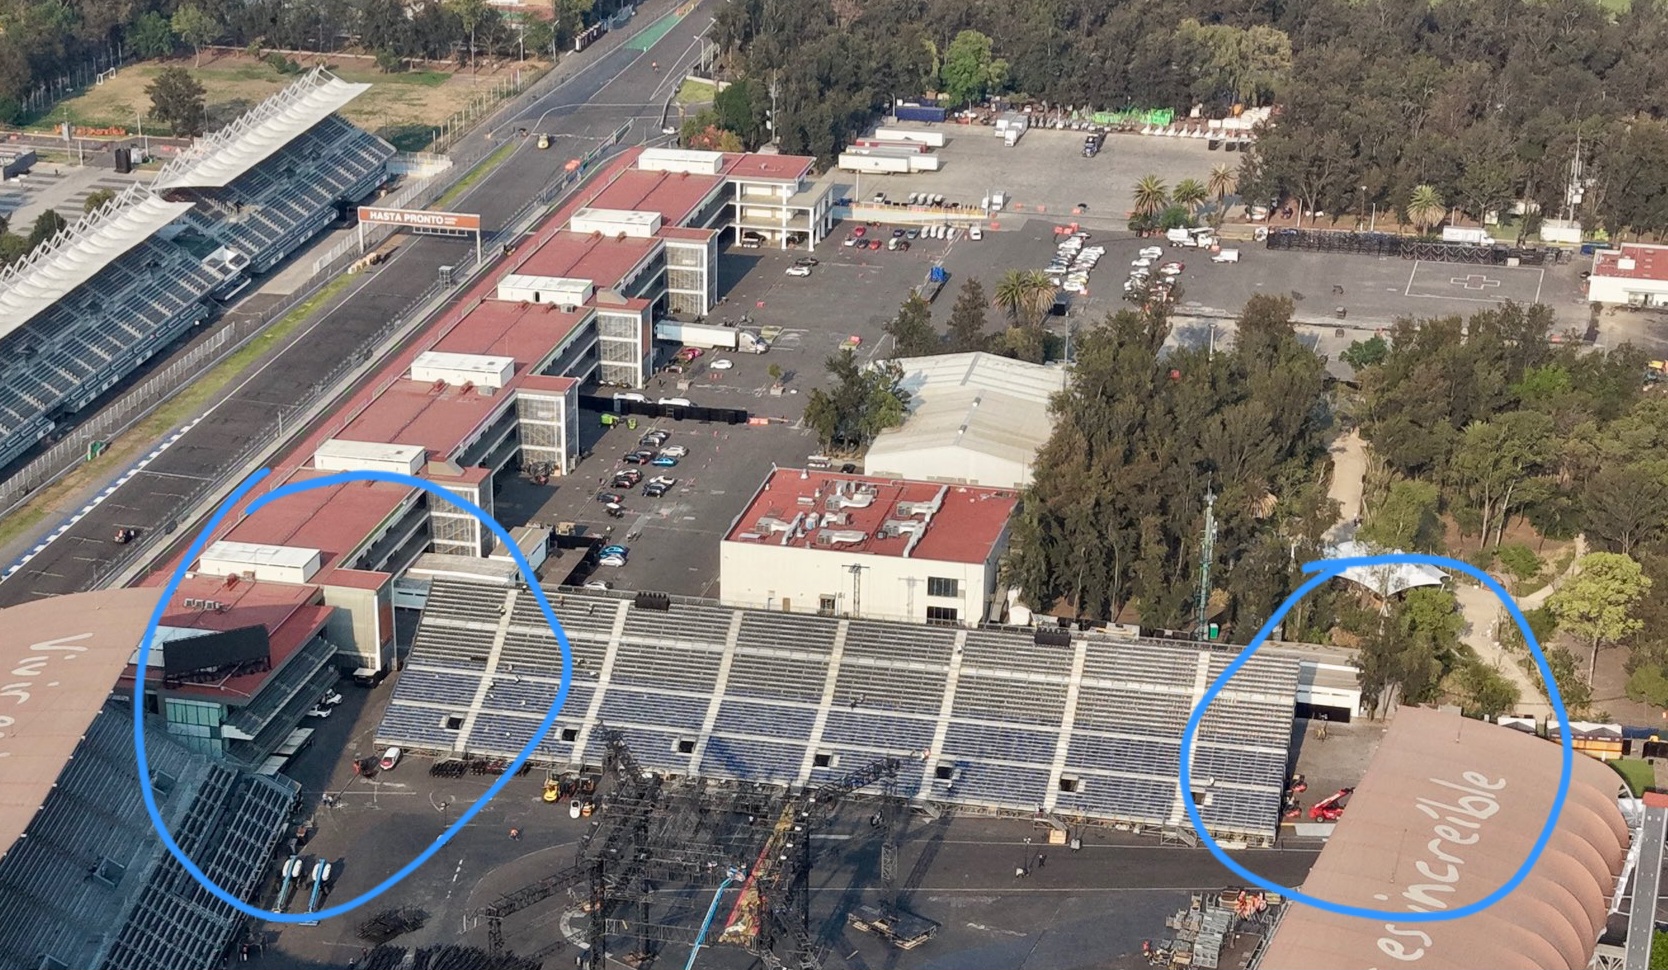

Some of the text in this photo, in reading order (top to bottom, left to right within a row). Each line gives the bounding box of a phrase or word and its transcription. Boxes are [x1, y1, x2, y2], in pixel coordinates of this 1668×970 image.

[369, 211, 402, 221] HASTA
[403, 213, 444, 225] PRONTO
[1377, 923, 1433, 961] es
